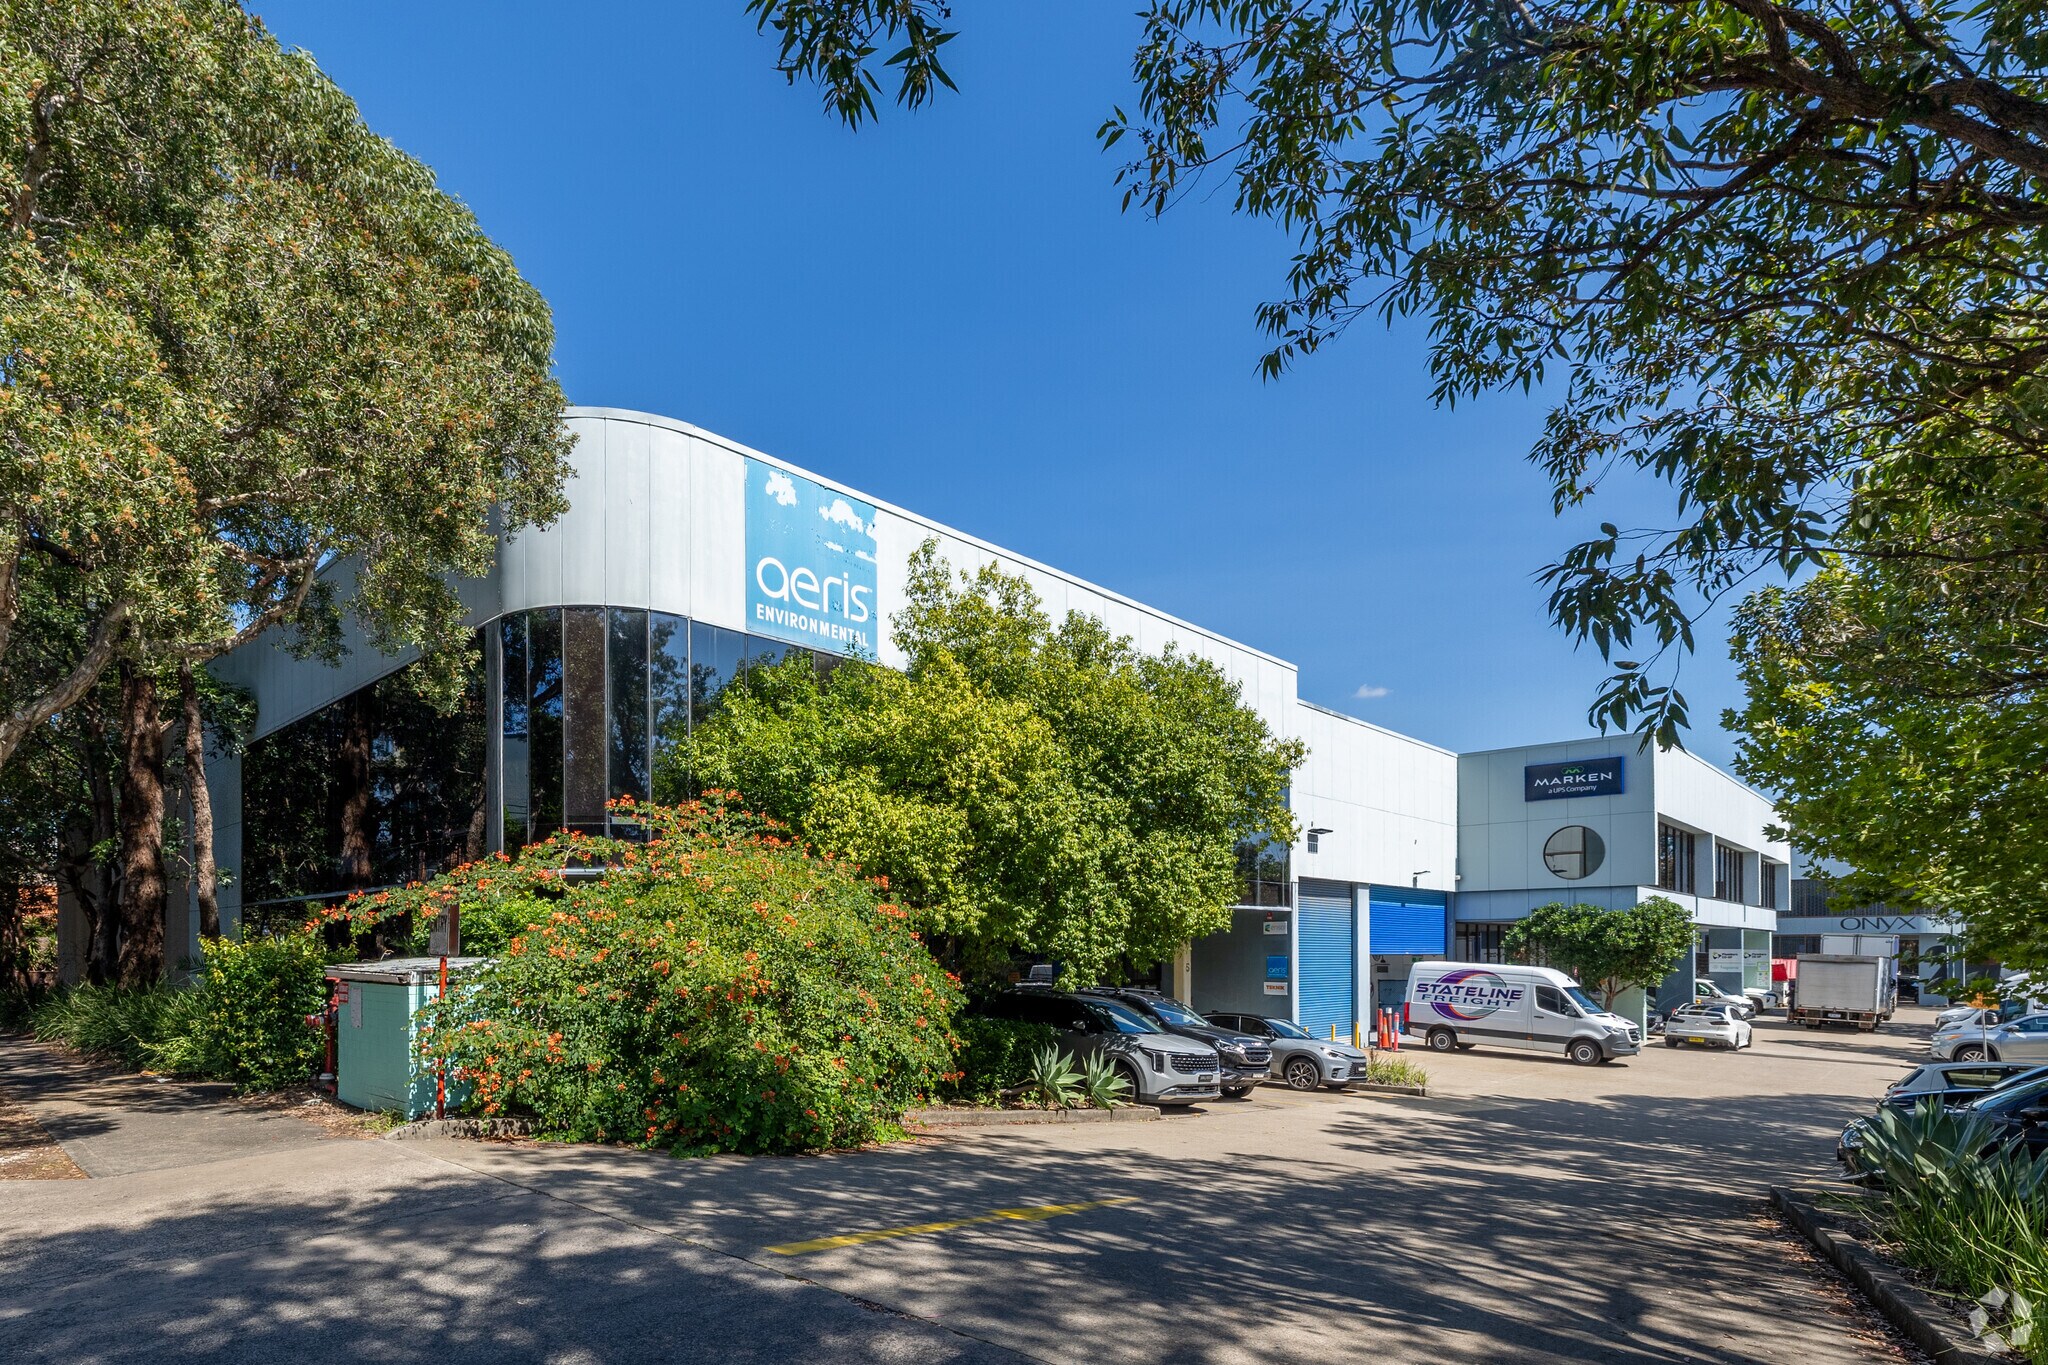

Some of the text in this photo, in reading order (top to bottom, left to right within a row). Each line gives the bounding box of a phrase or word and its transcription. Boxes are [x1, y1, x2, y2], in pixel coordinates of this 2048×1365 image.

[756, 556, 873, 623] aeris
[756, 603, 869, 647] ENVIRONMENTAL
[1534, 771, 1612, 787] MARKEN
[1553, 786, 1566, 794] UPS
[1566, 785, 1597, 793] Company
[1840, 916, 1917, 933] ONYX
[1415, 983, 1524, 1000] STATELINE
[1421, 994, 1516, 1007] FREIGHT
